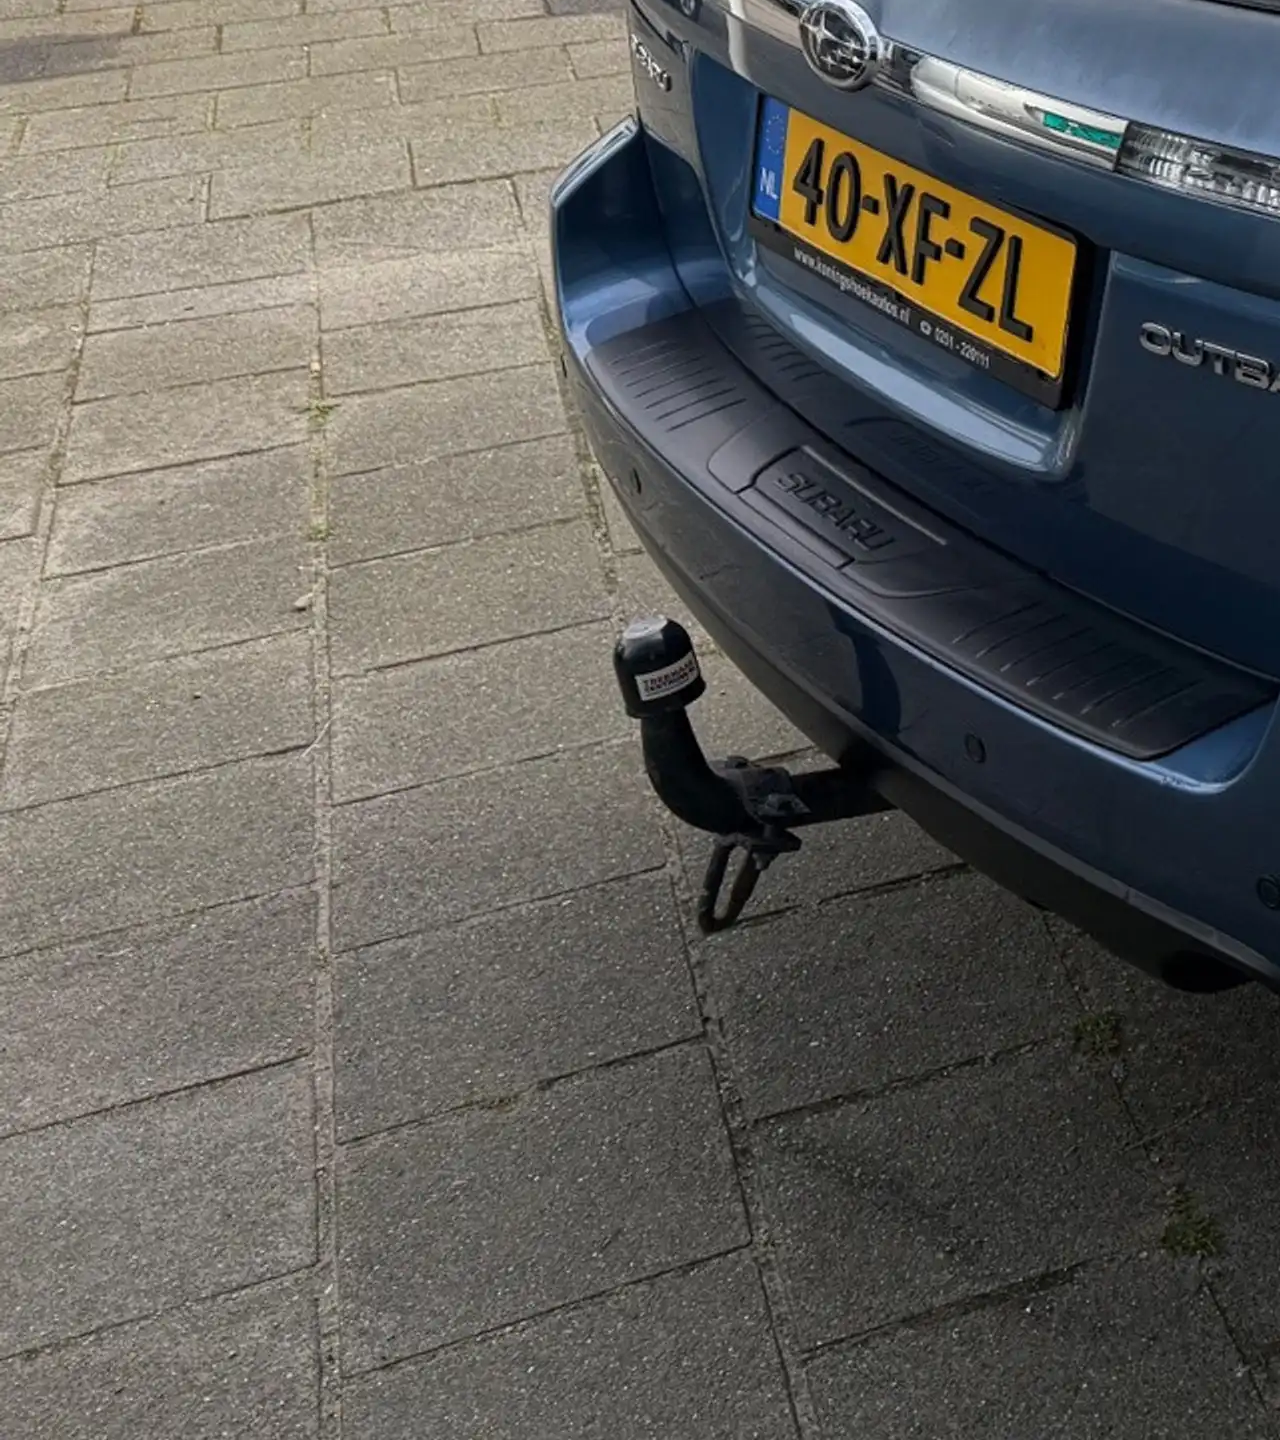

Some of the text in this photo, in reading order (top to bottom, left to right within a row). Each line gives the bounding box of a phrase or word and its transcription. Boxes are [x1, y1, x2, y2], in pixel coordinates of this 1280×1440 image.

[760, 165, 778, 200] NL
[793, 138, 1034, 343] 40-XF-ZL
[773, 472, 895, 551] SUBARU
